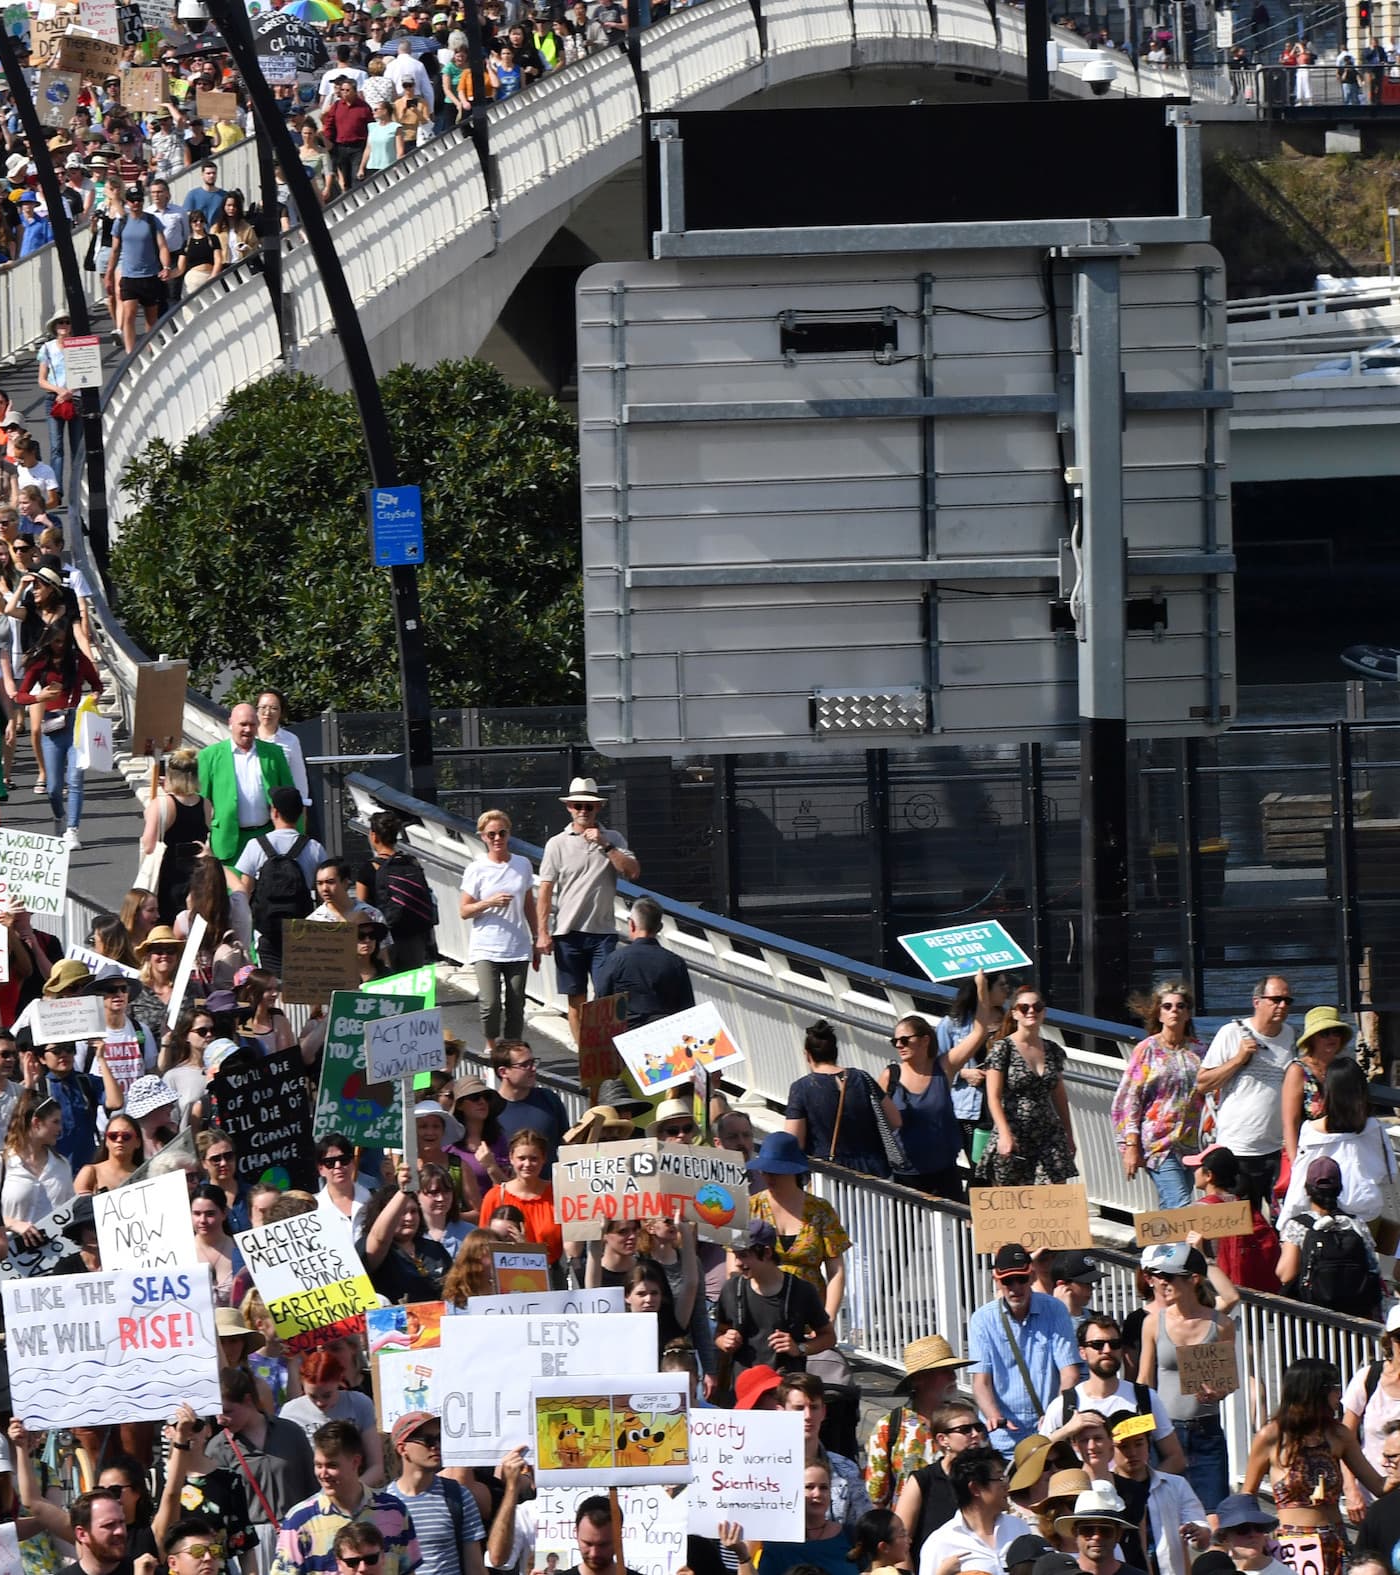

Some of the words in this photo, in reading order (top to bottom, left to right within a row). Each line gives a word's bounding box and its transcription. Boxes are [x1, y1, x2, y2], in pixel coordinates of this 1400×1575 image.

[377, 508, 416, 521] CitySafe
[7, 832, 45, 849] WORLD
[48, 836, 66, 855] IS
[34, 853, 56, 872] BY
[10, 868, 62, 888] EXAMPLE
[924, 926, 994, 949] RESPECT
[943, 942, 987, 957] YOUR
[354, 999, 377, 1015] IF
[372, 1020, 406, 1044] ACT
[409, 1019, 440, 1037] NOW
[401, 1040, 419, 1053] OR
[227, 1096, 245, 1111] OF
[280, 1076, 307, 1096] AGE
[317, 1088, 339, 1114] do
[226, 1115, 255, 1136] I'LL
[316, 1115, 341, 1130] or
[563, 1156, 628, 1181] THERE
[631, 1152, 657, 1177] IS
[660, 1153, 681, 1174] NO
[683, 1155, 750, 1187] ECONOMY
[590, 1177, 615, 1194] ON
[624, 1177, 640, 1193] A
[102, 1182, 157, 1227] ACT
[562, 1195, 618, 1223] DEAD
[623, 1192, 698, 1221] PLANET
[979, 1189, 1036, 1210] SCIENCE
[981, 1216, 1017, 1231] care
[1028, 1211, 1072, 1229] about
[1201, 1206, 1248, 1233] Better!
[114, 1212, 165, 1253] NOW
[241, 1213, 323, 1254] GLACIERS
[1020, 1230, 1081, 1248] OPINION!
[132, 1244, 150, 1259] OR
[499, 1254, 520, 1268] ACT
[290, 1248, 343, 1279] REEFS
[12, 1285, 66, 1315] LIKE
[75, 1280, 117, 1307] THE
[131, 1274, 191, 1306] SEAS
[269, 1289, 328, 1325] EARTH
[342, 1280, 357, 1297] IS
[12, 1323, 48, 1358] WE
[52, 1319, 106, 1355] WILL
[118, 1311, 194, 1352] RISE!
[526, 1318, 581, 1348] LET'S
[1192, 1344, 1219, 1360] OUR
[540, 1352, 569, 1377] BE
[1183, 1359, 1225, 1373] PLANET
[718, 1449, 734, 1465] be
[743, 1449, 793, 1465] worried
[711, 1470, 781, 1493] Scientists
[539, 1494, 565, 1514] Is
[697, 1499, 710, 1510] to
[715, 1490, 800, 1514] demonstrate!
[641, 1521, 683, 1553] Young
